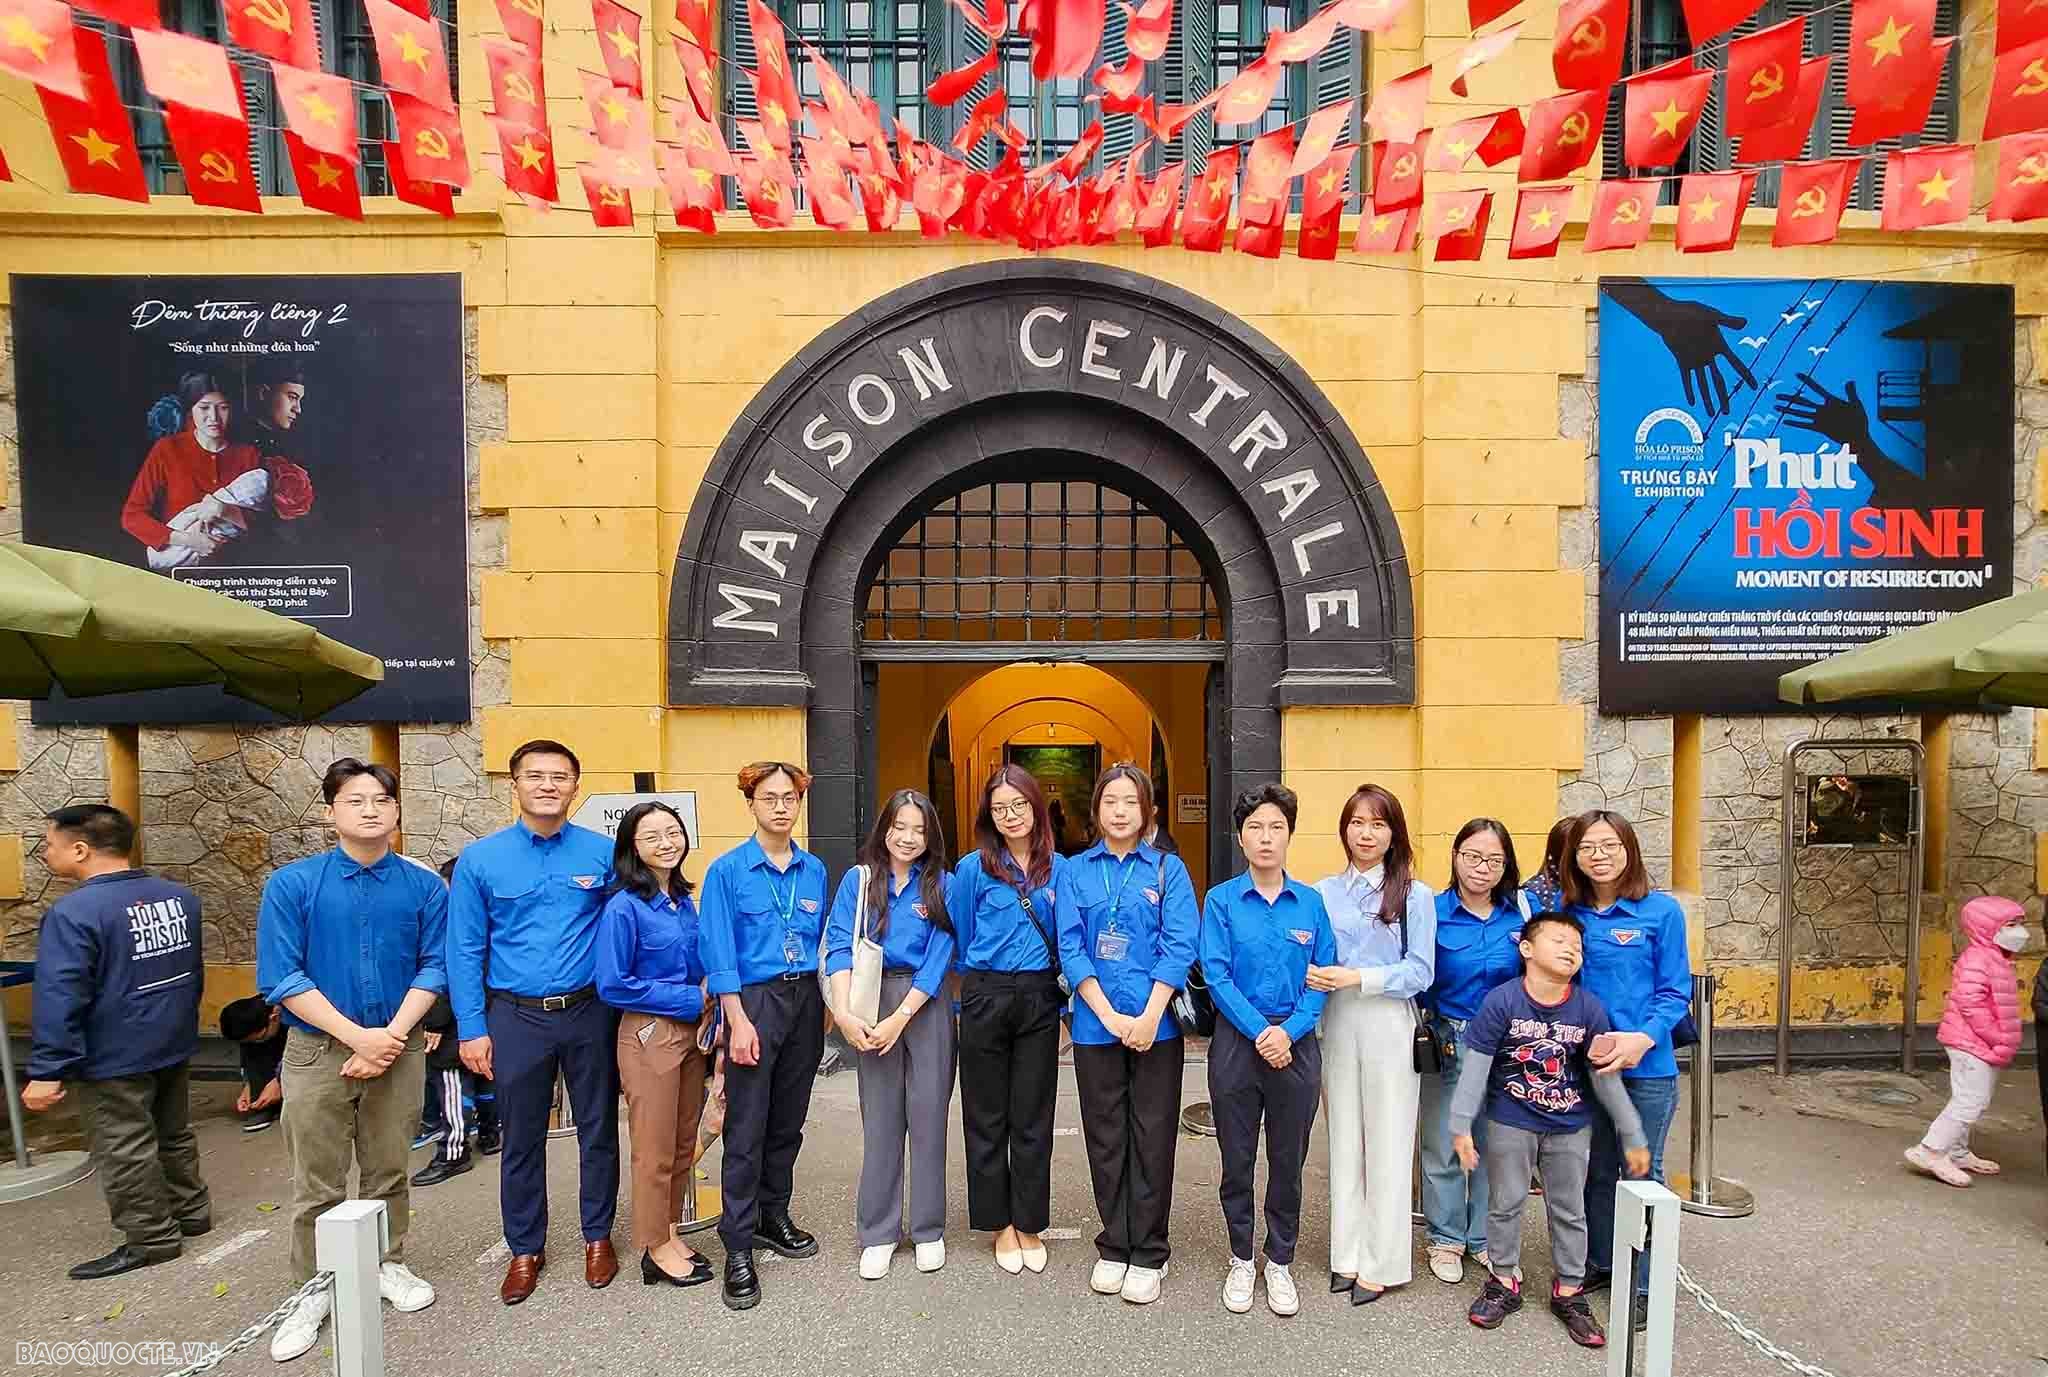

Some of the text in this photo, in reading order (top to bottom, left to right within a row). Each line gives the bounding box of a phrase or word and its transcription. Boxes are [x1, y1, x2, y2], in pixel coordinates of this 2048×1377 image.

[131, 300, 349, 337] Đêm thiêng liêng 2
[205, 342, 229, 352] như
[231, 341, 268, 354] những
[711, 306, 1361, 638] MAISON CENTRALE
[1621, 467, 1718, 485] TRƯNG BÀY
[1634, 487, 1704, 497] EXHIBITION
[1732, 488, 1984, 559] HỒI SINH
[223, 578, 246, 586] trình
[248, 577, 283, 587] thường
[285, 576, 306, 585] diễn
[320, 576, 337, 585] vào
[1736, 571, 1823, 589] MOMENT
[1824, 570, 1848, 587] OF
[250, 588, 267, 596] thứ
[290, 588, 308, 596] thứ
[268, 599, 283, 607] 120
[285, 599, 308, 608] phút
[1660, 612, 1669, 622] 50
[1628, 627, 1638, 637] 48
[384, 658, 403, 668] tiếp
[404, 658, 417, 668] tại
[444, 658, 455, 666] vé
[130, 919, 189, 952] PRISON
